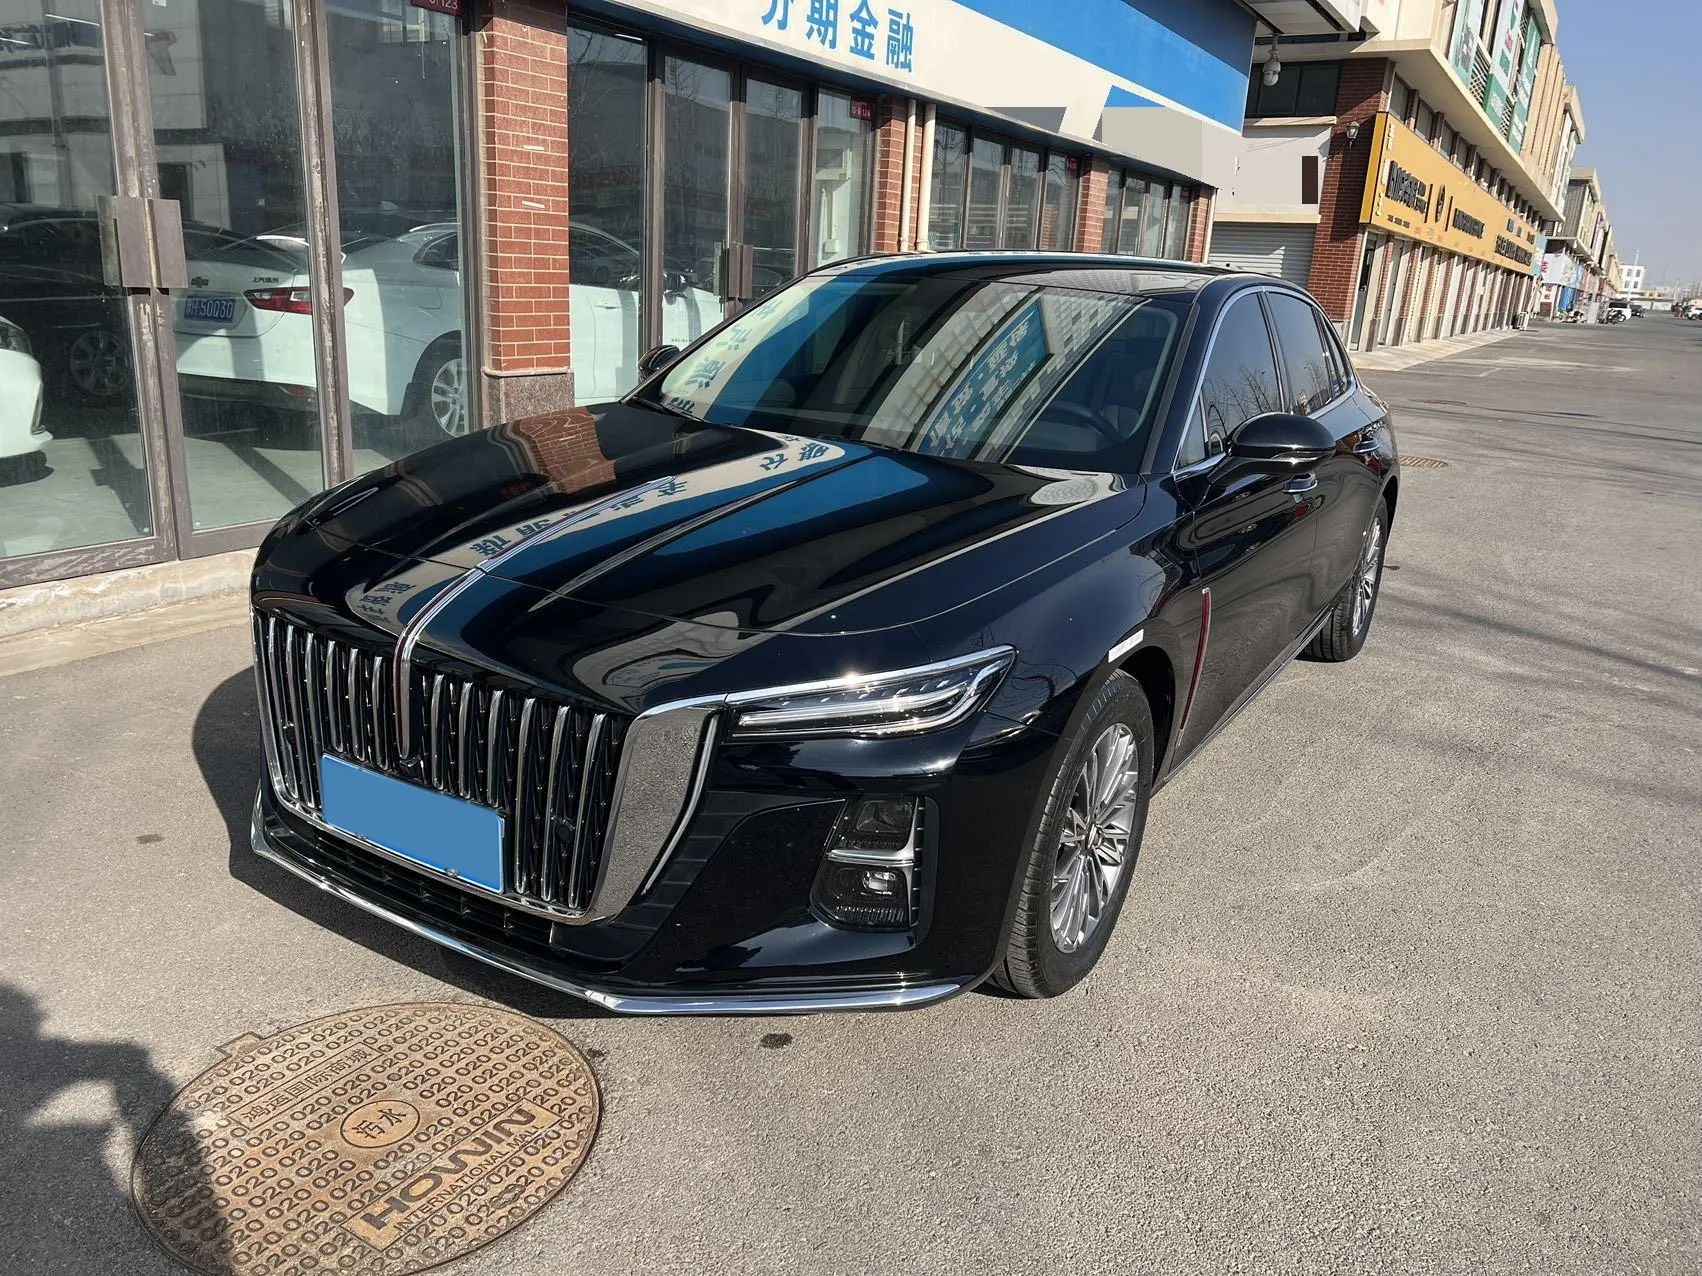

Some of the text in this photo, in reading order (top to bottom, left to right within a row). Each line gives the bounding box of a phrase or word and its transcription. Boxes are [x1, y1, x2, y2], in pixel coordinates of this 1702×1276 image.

[241, 1048, 373, 1122] 鸿运国际商城
[351, 1108, 407, 1139] 污水
[392, 1125, 545, 1232] INTERNATIONAL MALL
